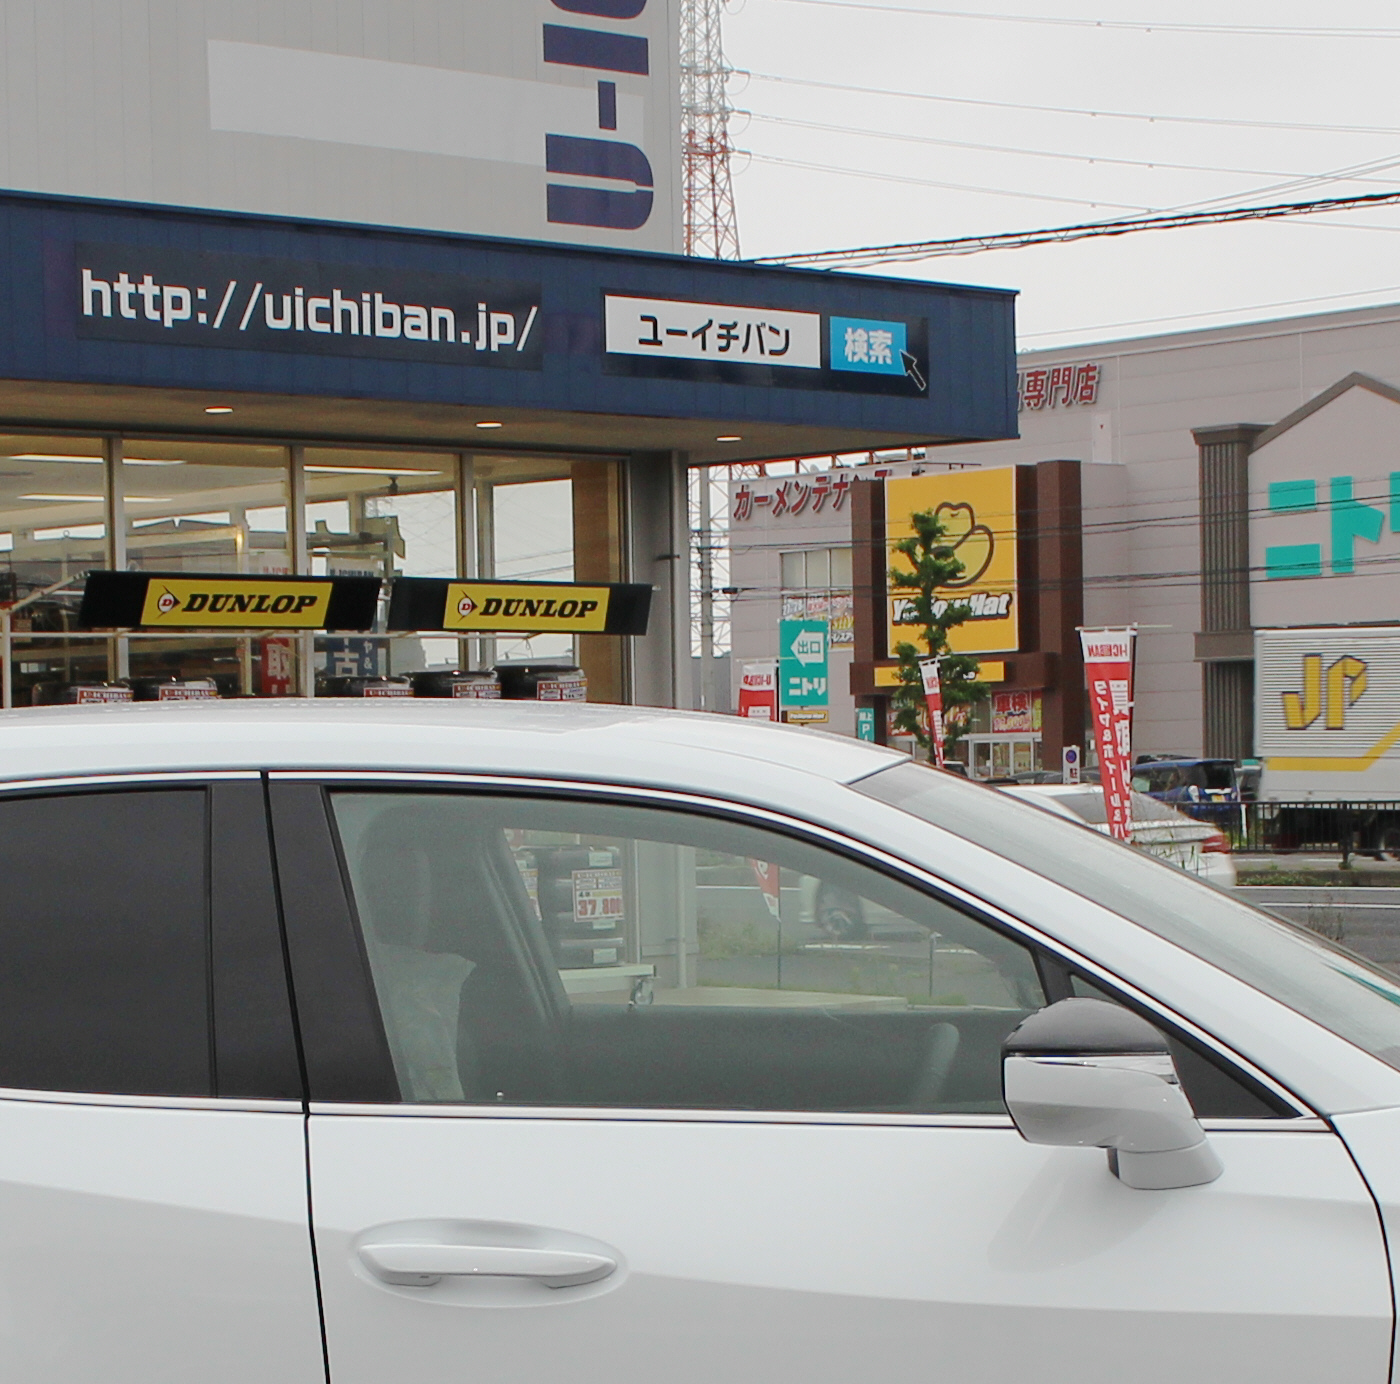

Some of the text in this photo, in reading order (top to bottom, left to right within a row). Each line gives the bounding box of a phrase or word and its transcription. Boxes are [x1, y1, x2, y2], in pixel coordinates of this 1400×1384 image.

[543, 0, 654, 230] U-I
[81, 268, 538, 353] http://uichiban.jp/
[638, 314, 791, 358] ユーイチバン
[843, 326, 894, 366] 検索
[1017, 362, 1099, 412] 専門店
[733, 467, 893, 520] カーメンテナ
[182, 593, 318, 614] DUNLOP
[480, 597, 598, 618] DUNLOP
[789, 677, 826, 696] ニトリ
[1282, 653, 1368, 731] JP
